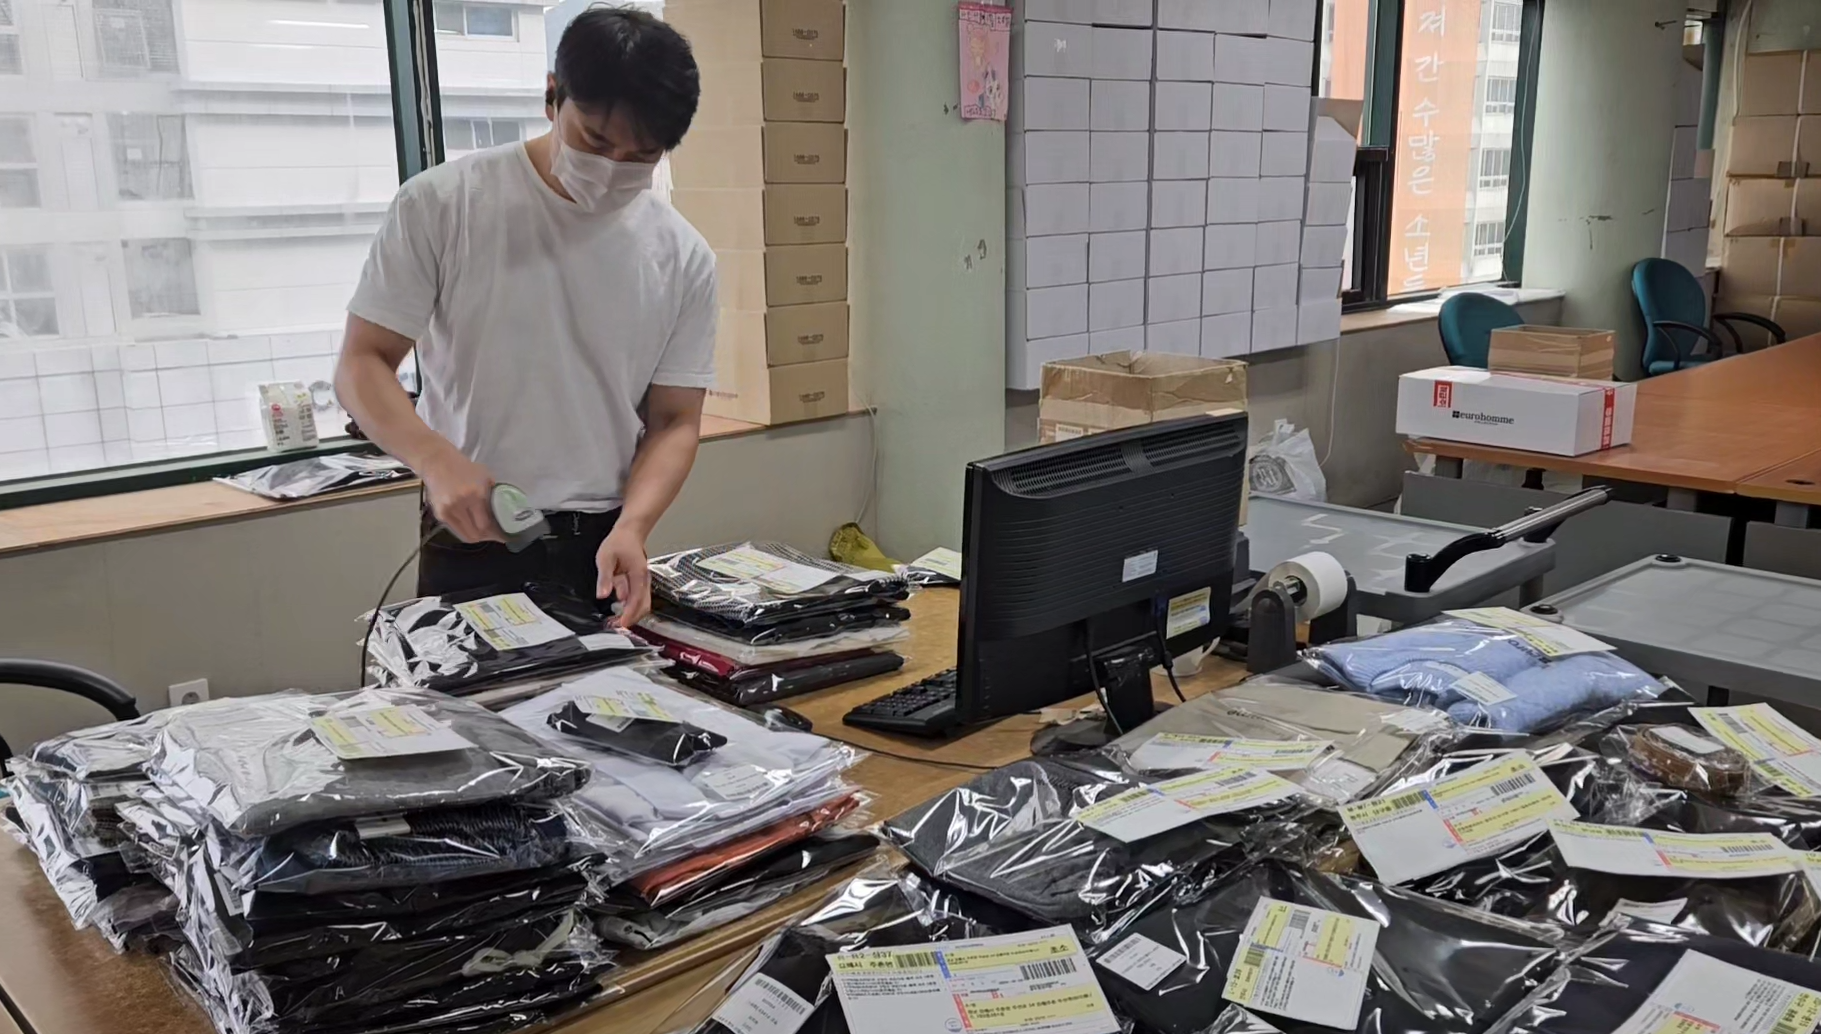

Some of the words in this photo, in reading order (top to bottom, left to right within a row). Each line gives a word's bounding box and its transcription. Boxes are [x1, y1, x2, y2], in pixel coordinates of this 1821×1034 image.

[1414, 49, 1444, 82] 간
[1406, 97, 1440, 194] 수많은
[1460, 411, 1515, 425] eurohomme
